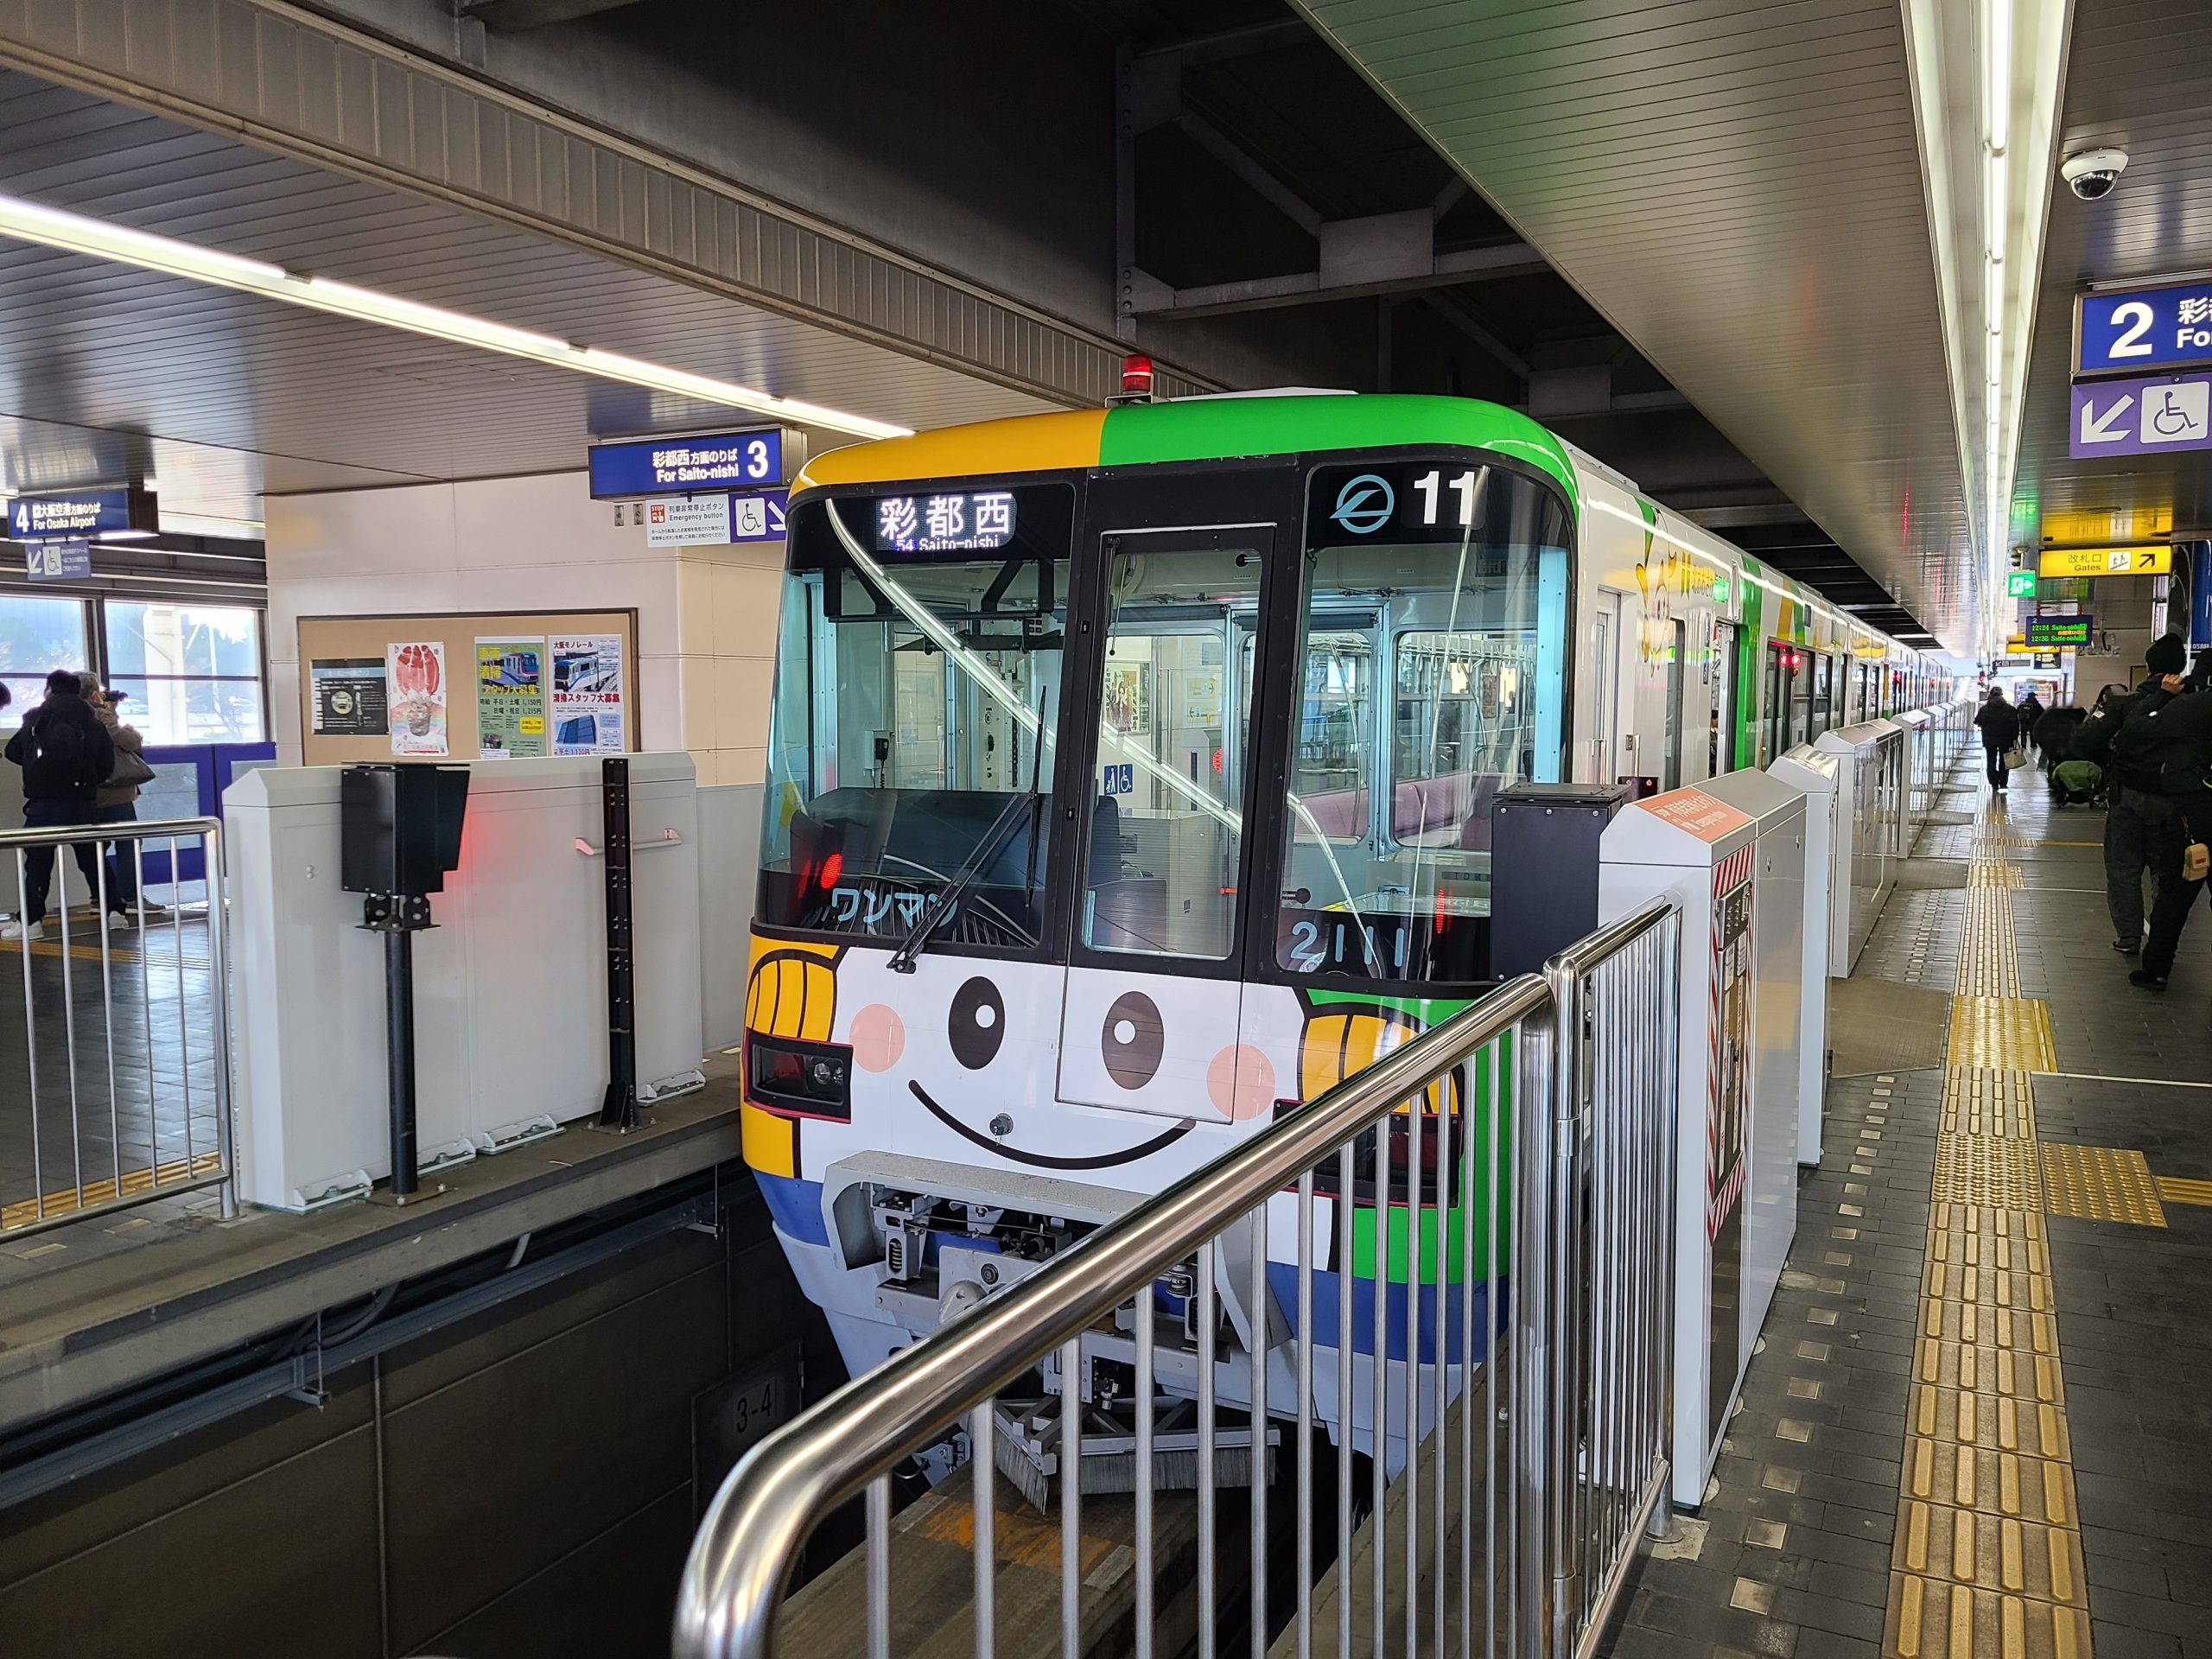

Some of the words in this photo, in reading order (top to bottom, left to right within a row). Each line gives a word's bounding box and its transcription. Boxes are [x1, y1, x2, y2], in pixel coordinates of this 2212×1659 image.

[2177, 296, 2212, 325] 彩
[2109, 302, 2154, 359] 2
[2177, 327, 2212, 349] Fo
[652, 448, 738, 468] 彩都西方面のりば
[747, 440, 768, 478] 3
[657, 469, 677, 483] For
[678, 463, 739, 481] Saito-nishi
[669, 503, 724, 513] 列車非常停止ボタン
[1414, 471, 1474, 524] 11
[16, 505, 29, 532] 4
[34, 519, 46, 531] For
[47, 517, 69, 529] Osaka
[70, 516, 96, 530] Airport
[880, 493, 1012, 540] 彩都西
[2069, 554, 2102, 563] 改札口
[553, 693, 620, 703] 清掃スタッフ大募集
[1290, 921, 1405, 968] 2111
[736, 1384, 772, 1433] 3-4
